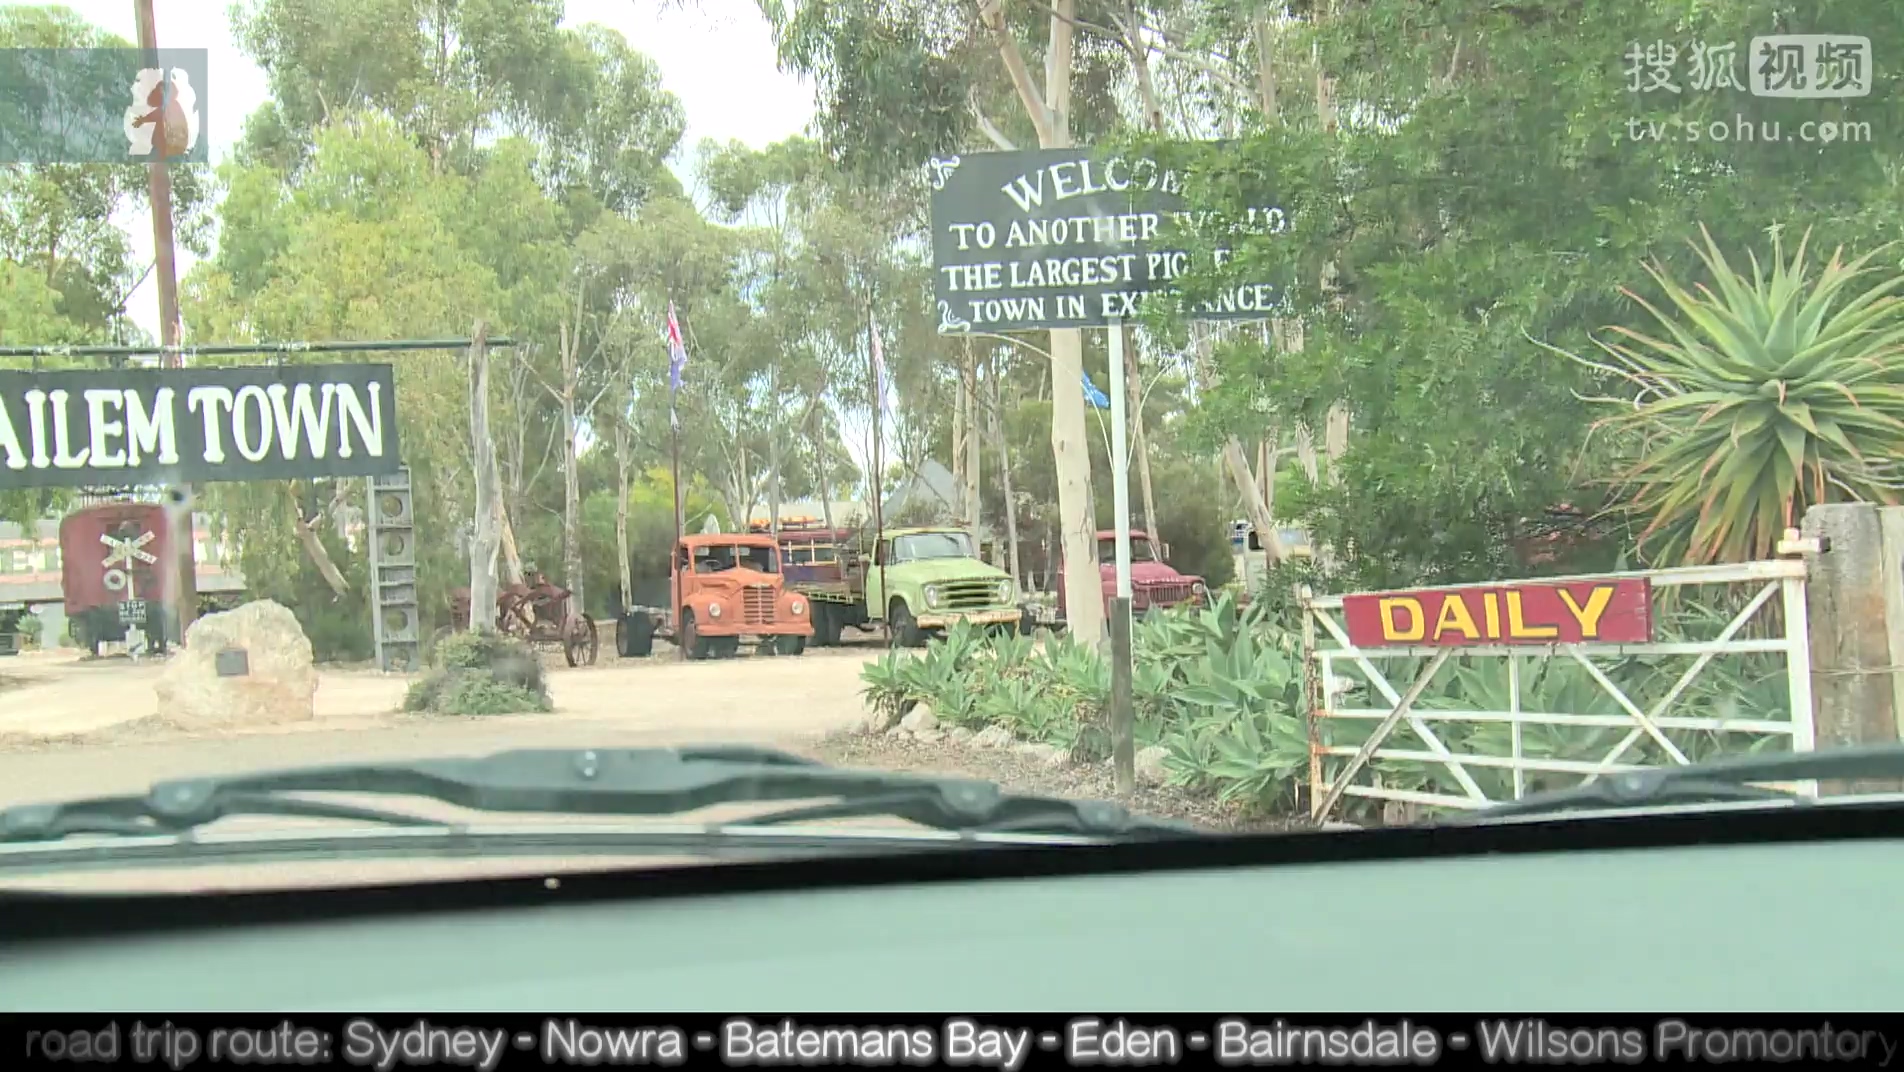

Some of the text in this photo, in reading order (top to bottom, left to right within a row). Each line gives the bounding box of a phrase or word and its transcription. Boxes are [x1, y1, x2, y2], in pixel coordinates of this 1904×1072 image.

[1001, 156, 1191, 213] WELCOM
[949, 221, 996, 250] TO
[1005, 212, 1159, 248] ANOTHER
[941, 262, 1002, 291] THE
[1009, 252, 1137, 288] LARGEST
[968, 297, 1046, 323] TOWN
[1055, 294, 1087, 319] IN
[188, 380, 384, 464] TOWN
[1378, 585, 1617, 641] DAILY
